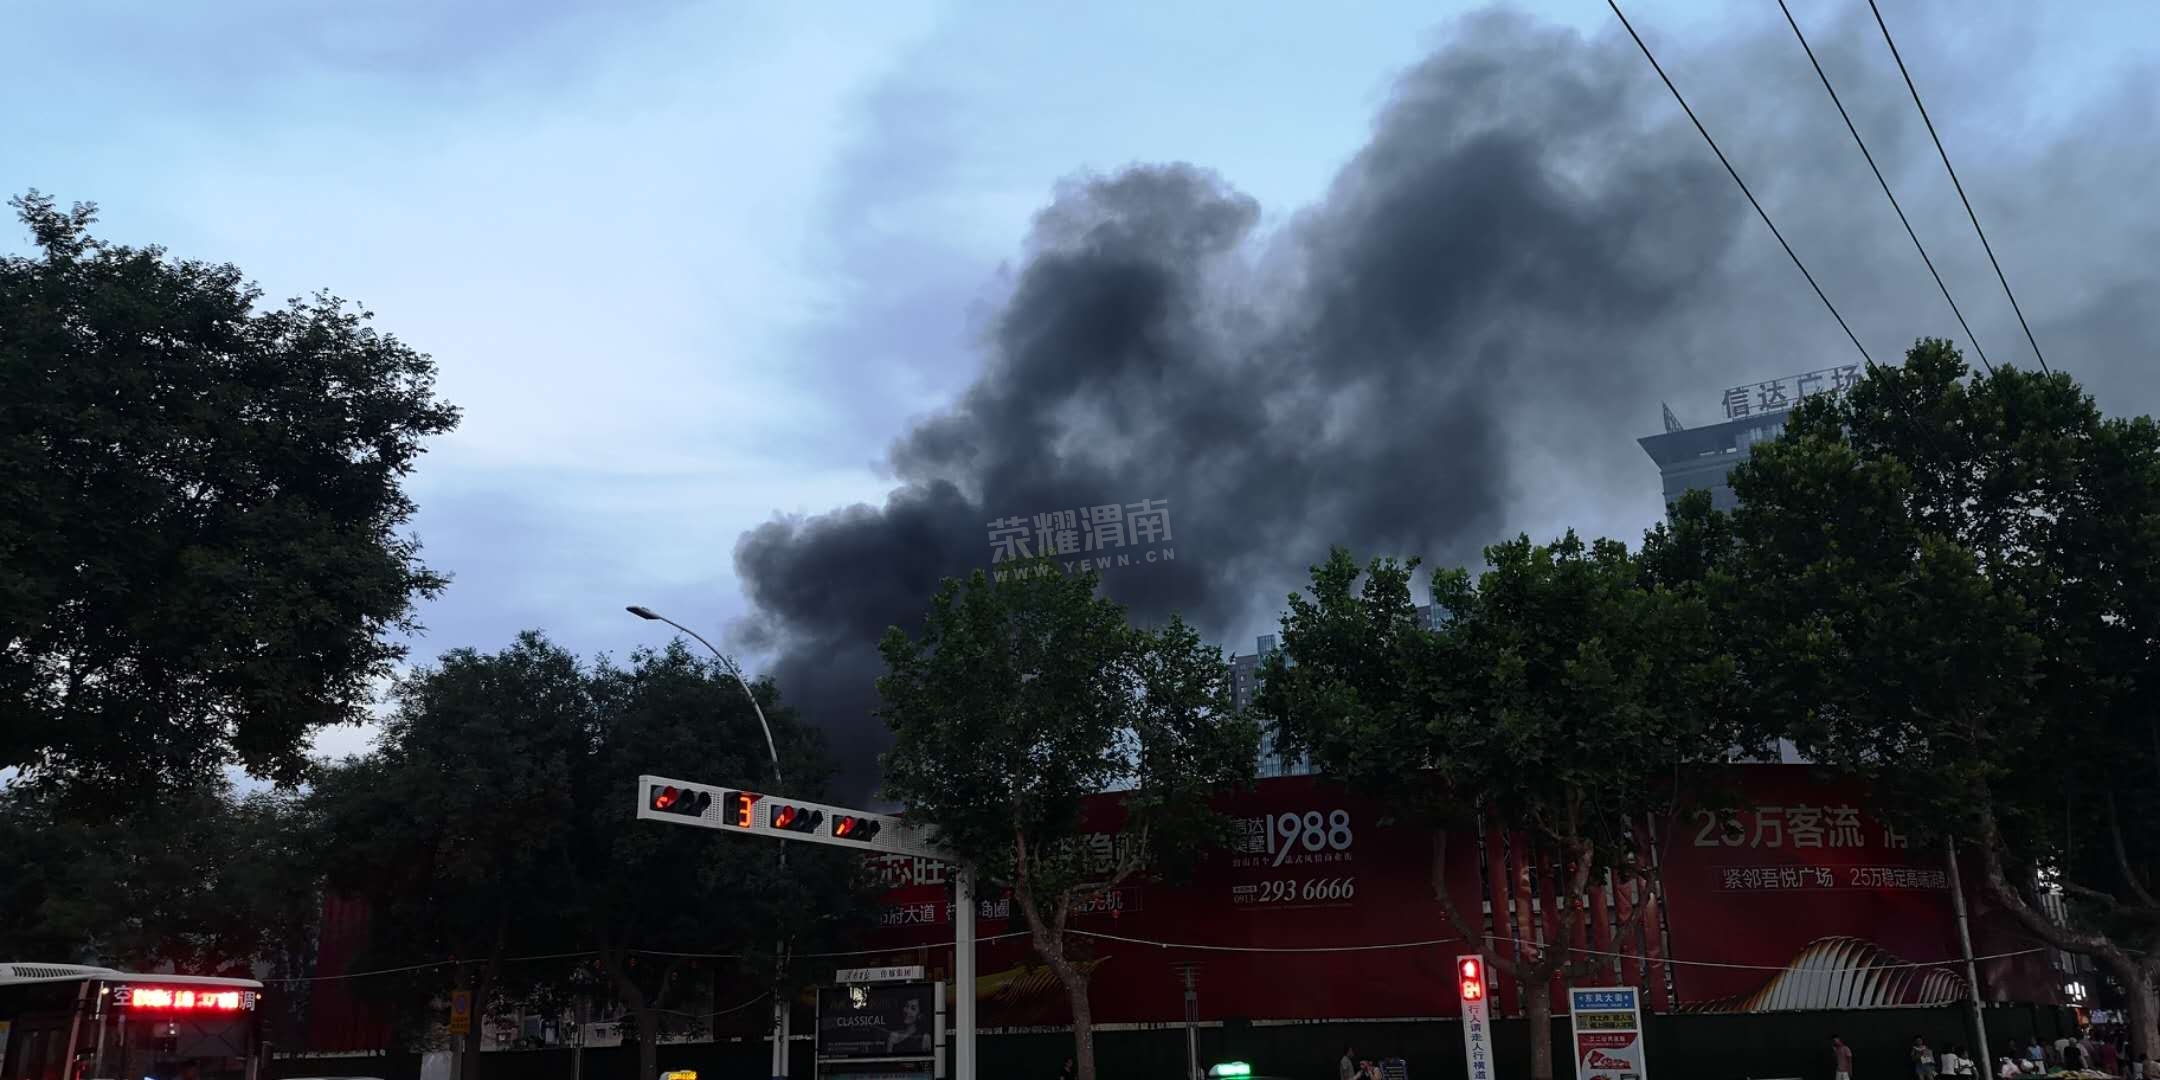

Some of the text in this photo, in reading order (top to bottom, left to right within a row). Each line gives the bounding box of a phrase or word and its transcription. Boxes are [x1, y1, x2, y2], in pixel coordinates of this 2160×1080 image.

[1721, 363, 1859, 418] 信达广场
[738, 796, 751, 828] 3
[1265, 809, 1353, 868] 1988
[1258, 879, 1297, 902] 293
[1302, 876, 1355, 901] 6666
[1723, 866, 1834, 889] 紧邻吾悦广场
[112, 985, 132, 1007] 空
[836, 1015, 887, 1028] CLASSICAL
